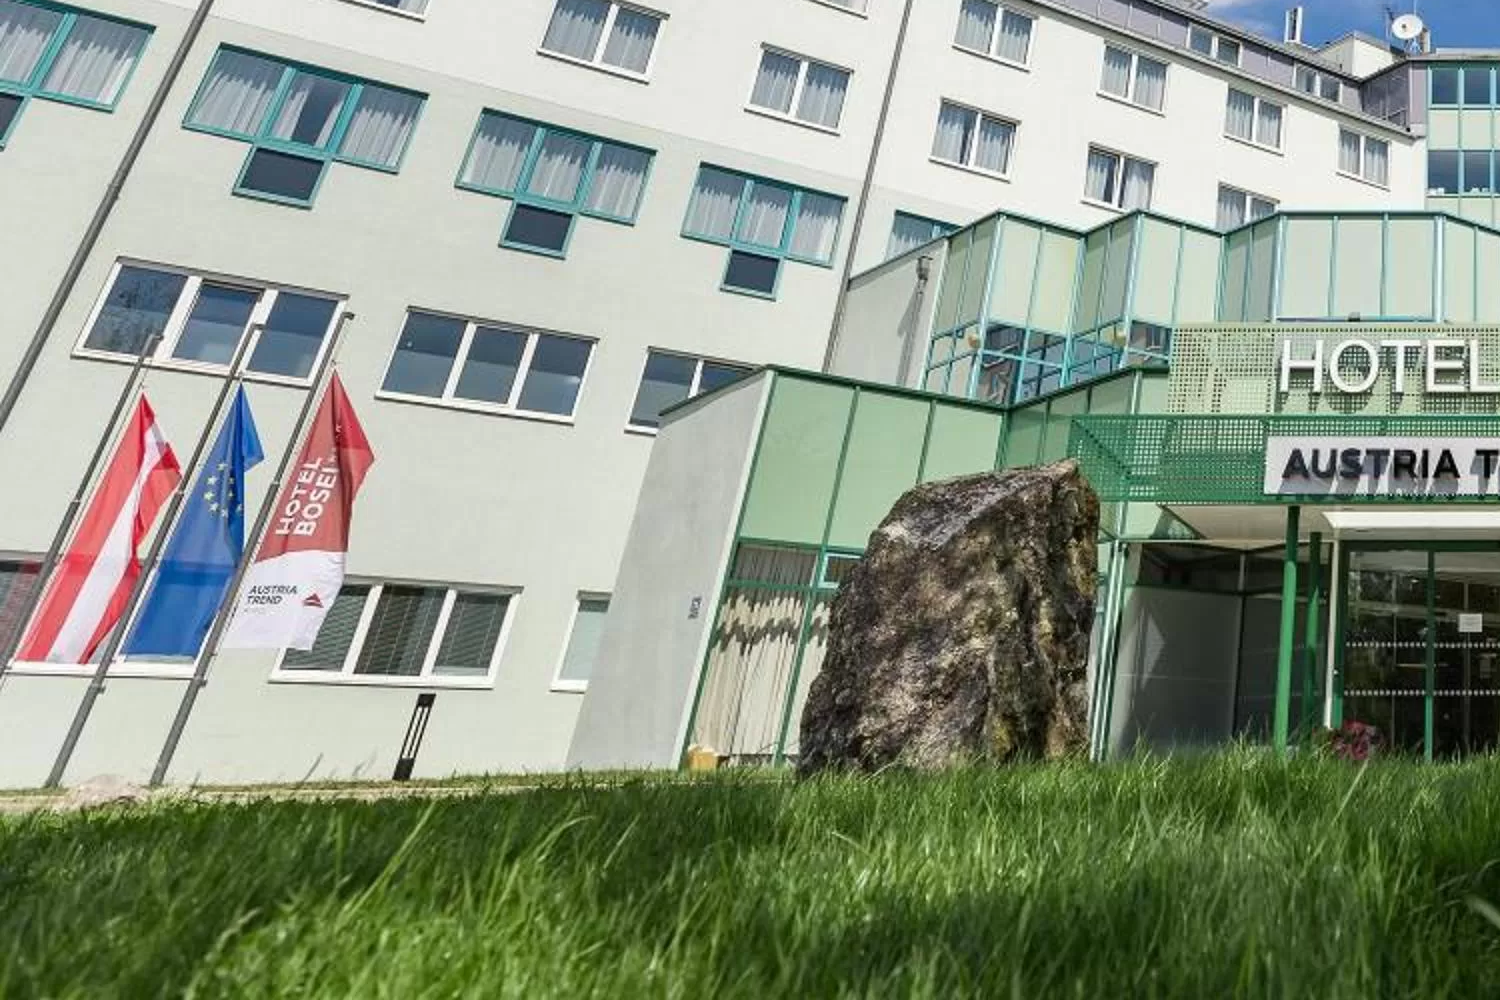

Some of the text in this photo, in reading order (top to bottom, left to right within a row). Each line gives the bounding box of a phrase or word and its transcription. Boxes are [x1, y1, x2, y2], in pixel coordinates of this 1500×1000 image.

[1282, 448, 1460, 479] AUSTRIA
[275, 456, 322, 535] HOTEL
[292, 466, 339, 536] BOSEI
[247, 595, 283, 605] TREND
[248, 585, 298, 594] AUSTRIA
